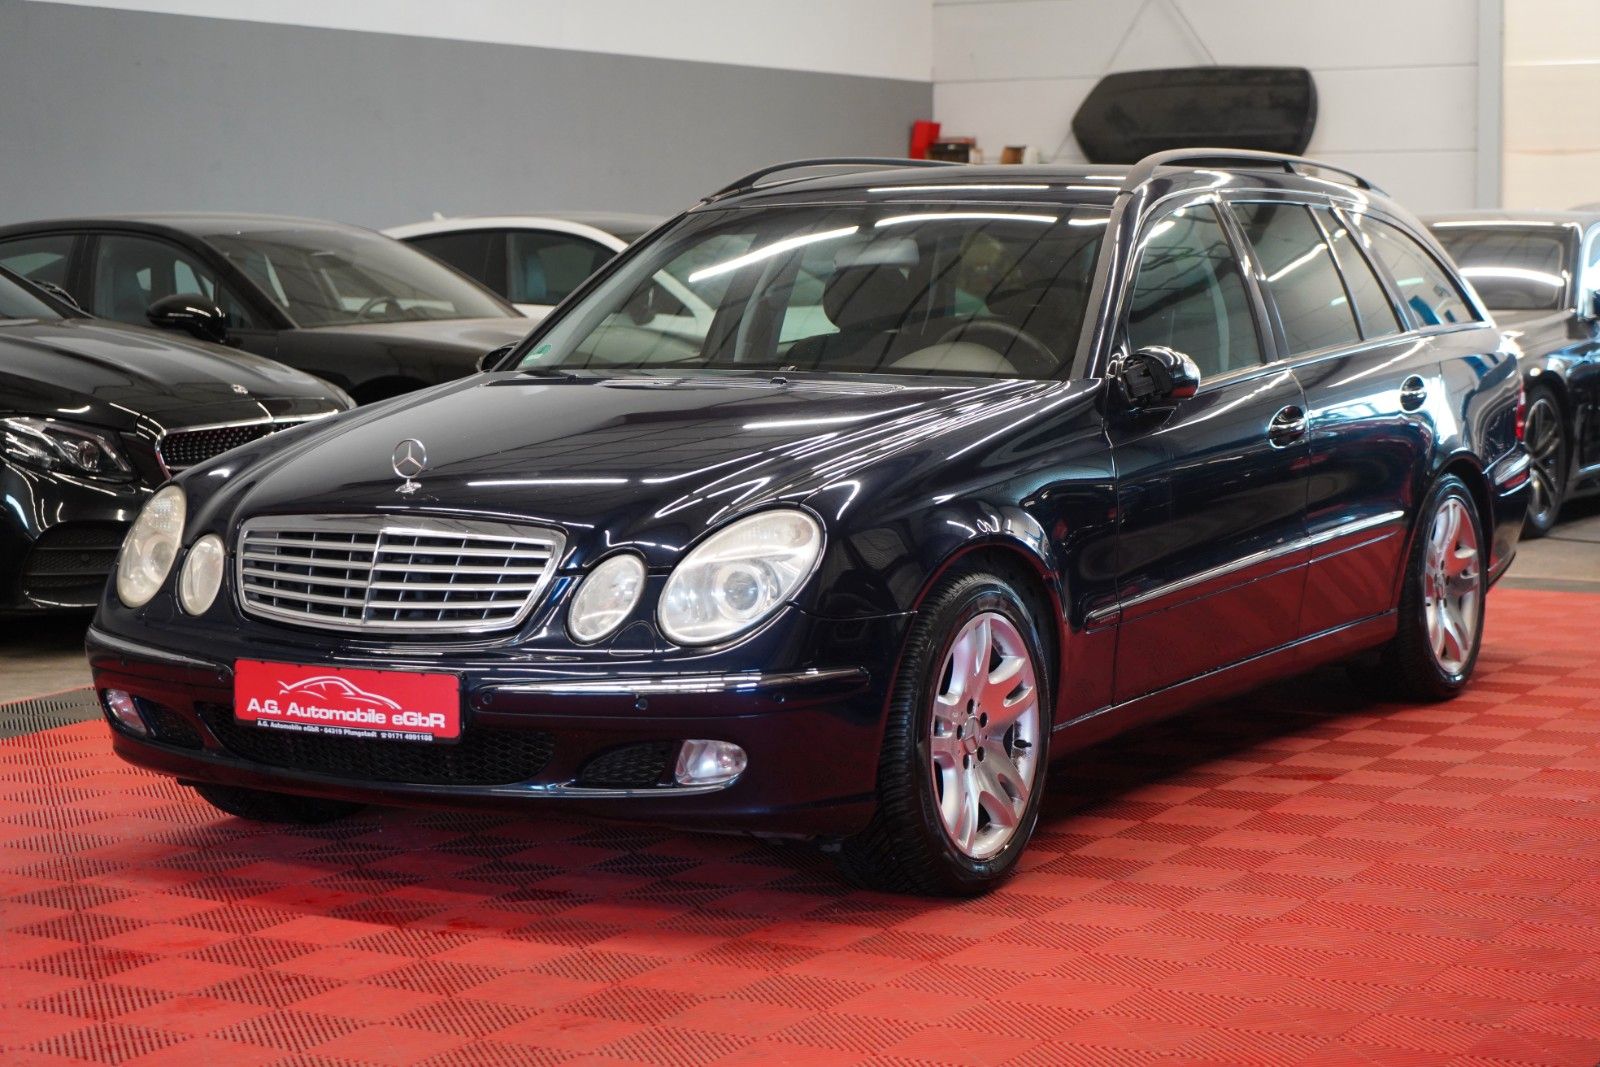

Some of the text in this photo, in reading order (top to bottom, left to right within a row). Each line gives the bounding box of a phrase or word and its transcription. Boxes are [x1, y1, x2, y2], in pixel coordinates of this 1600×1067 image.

[246, 698, 446, 729] A.G. Automobile eGbR
[270, 721, 302, 731] Automobile
